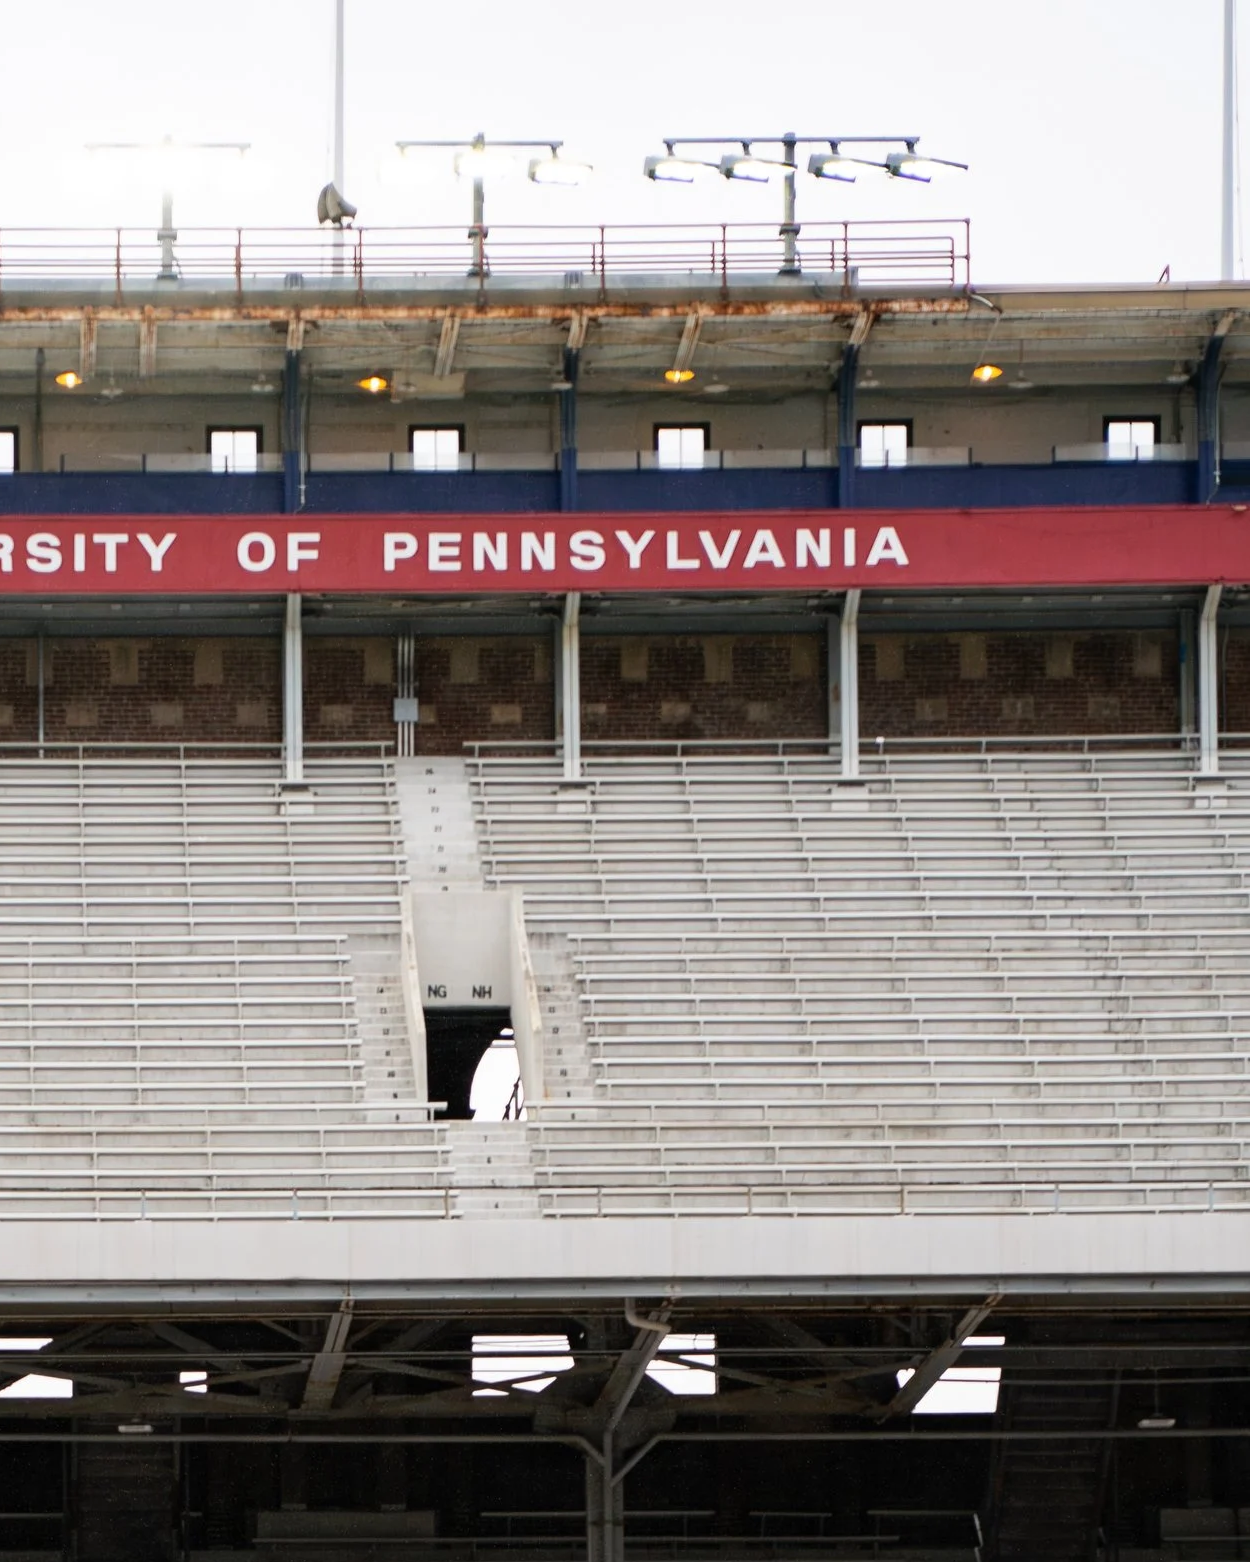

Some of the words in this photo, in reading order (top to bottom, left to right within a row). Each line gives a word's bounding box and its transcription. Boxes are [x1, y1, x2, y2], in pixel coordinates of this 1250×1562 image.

[236, 532, 322, 572] OF
[382, 526, 910, 572] PENNSYLVANIA
[427, 984, 447, 999] NG
[472, 985, 492, 999] NH
